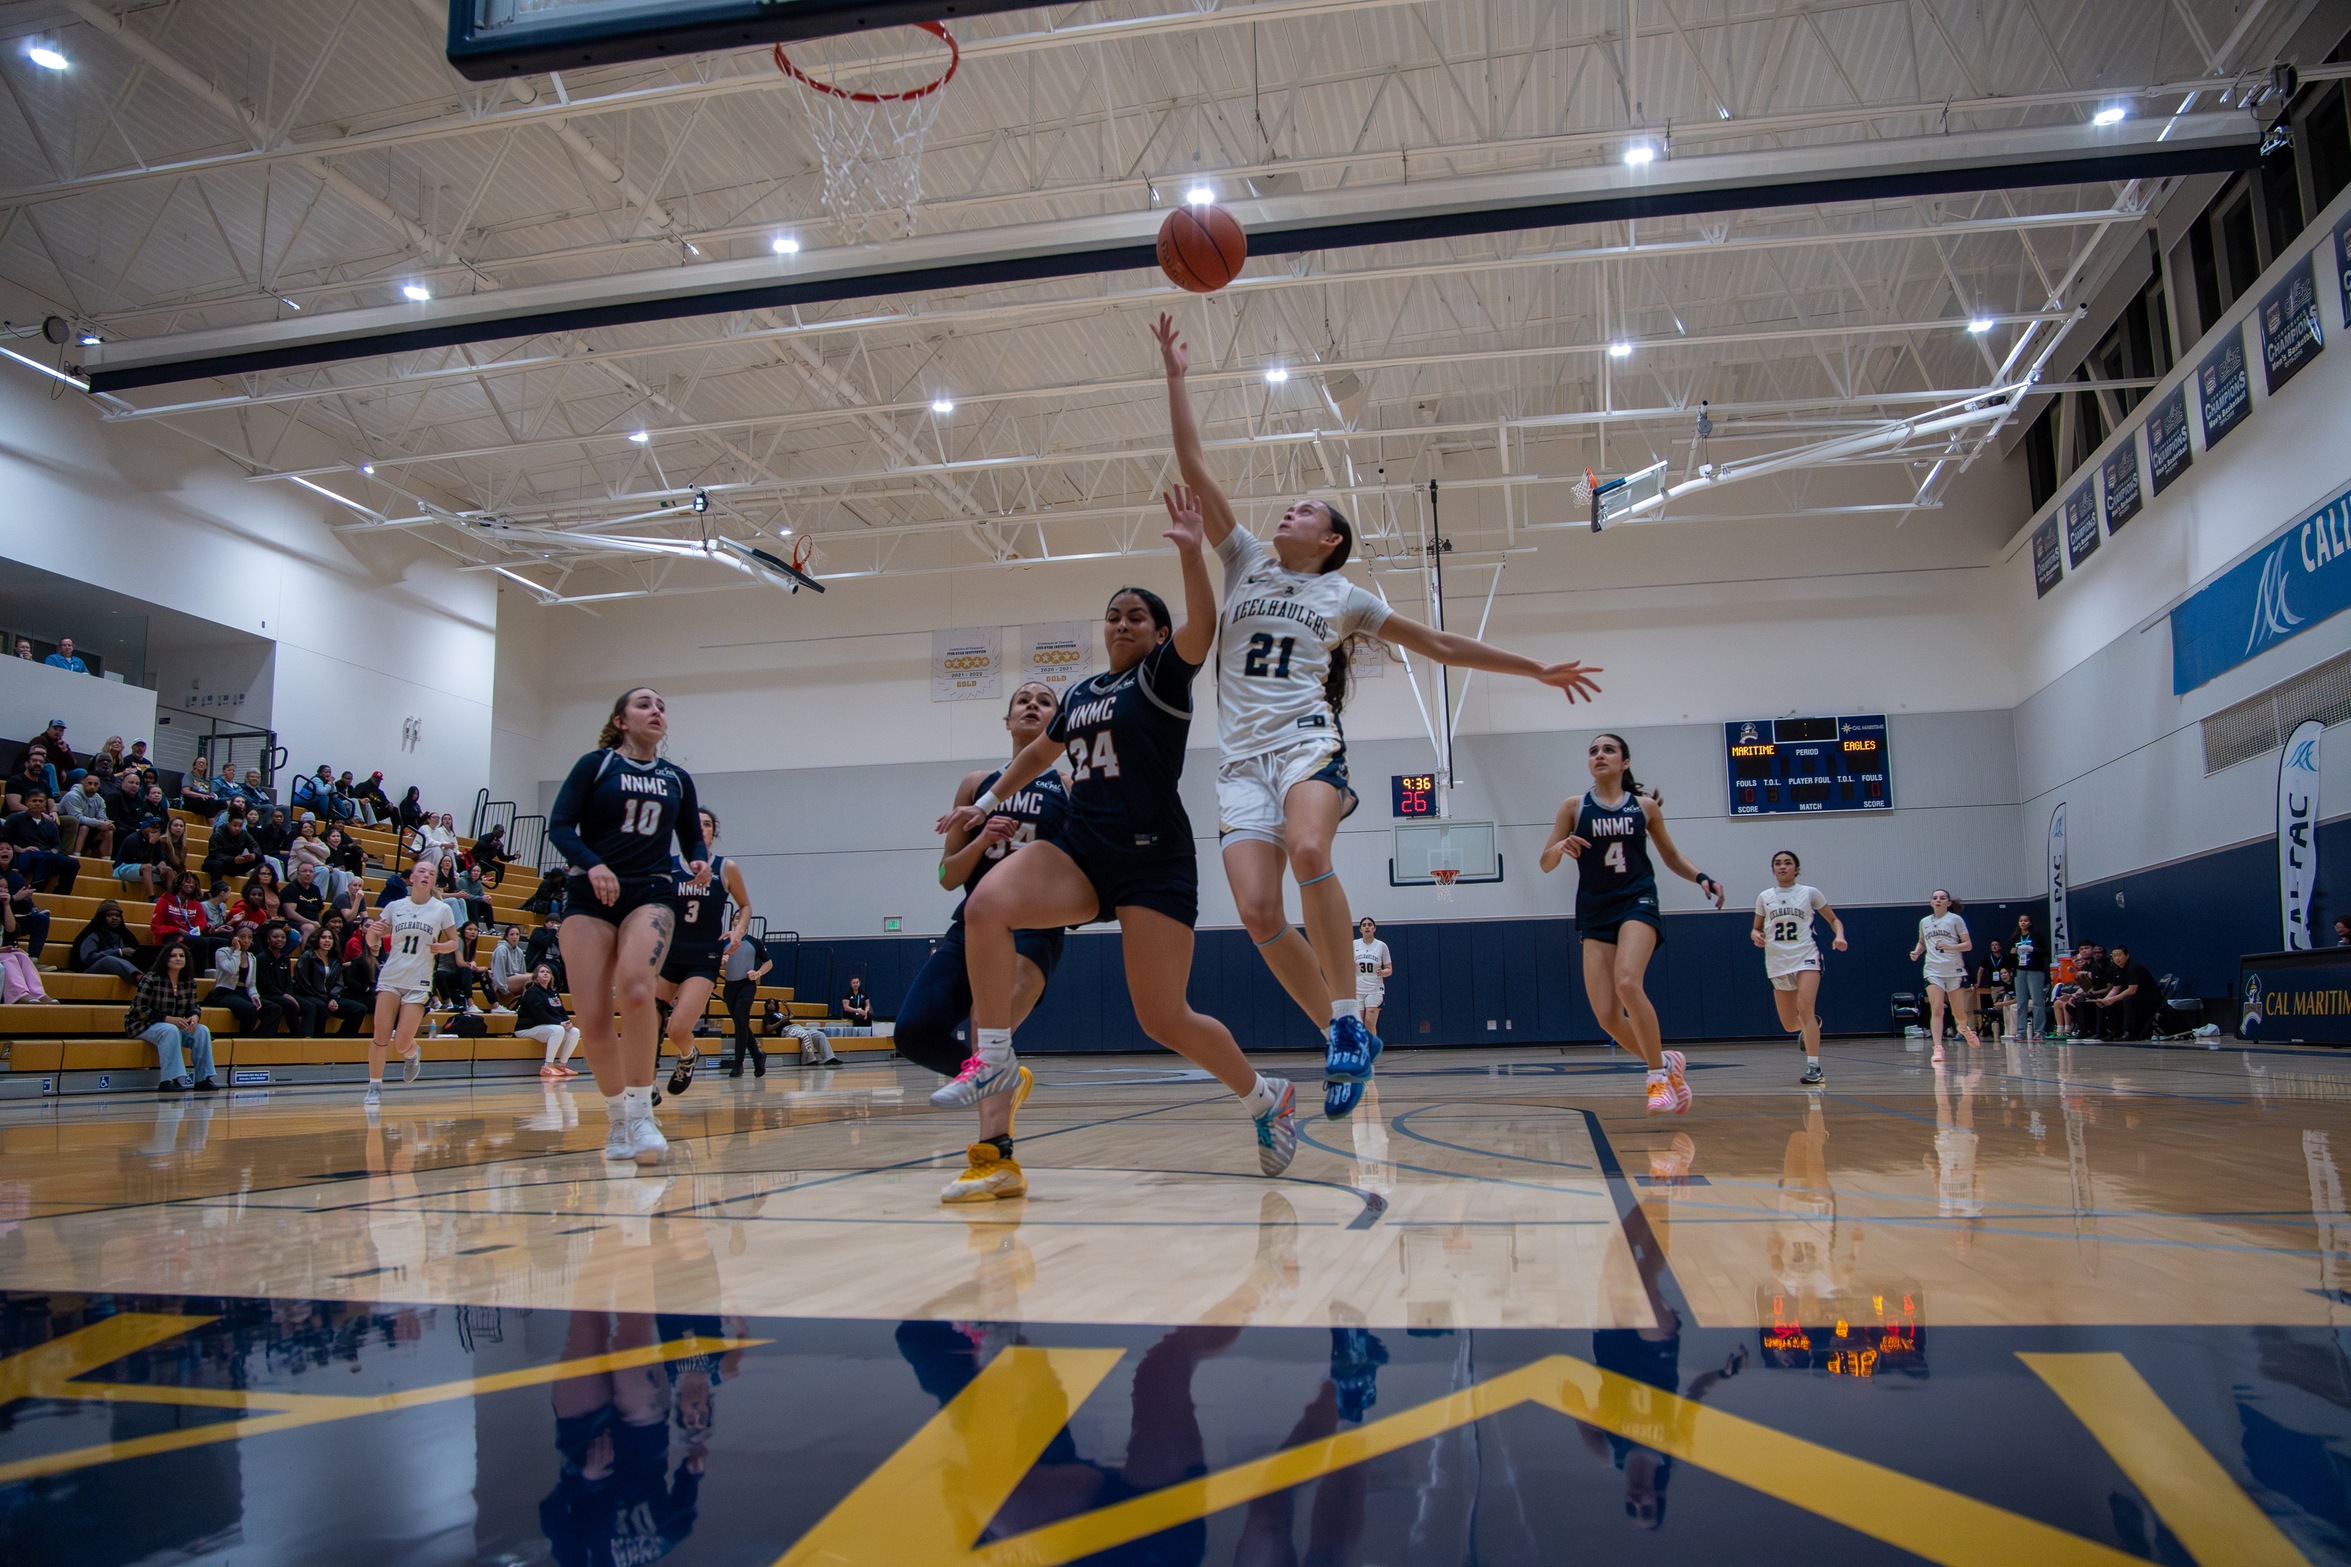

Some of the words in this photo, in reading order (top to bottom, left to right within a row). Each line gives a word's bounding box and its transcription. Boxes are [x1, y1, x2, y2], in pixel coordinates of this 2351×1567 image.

[2204, 370, 2246, 420] CHAMPIONS
[1232, 598, 1328, 642] KEELHAULERS
[1244, 632, 1296, 678] 21
[1066, 696, 1117, 732] NNMC
[1069, 730, 1120, 781] 24
[1732, 745, 1774, 756] MARITIME
[1844, 741, 1875, 751] EAGLES
[621, 774, 668, 796] NNMC
[1403, 778, 1430, 790] 9:36
[994, 791, 1043, 815] NMC
[1402, 791, 1427, 812] 26
[621, 799, 662, 836] 10
[1592, 817, 1634, 837] NNMC
[1604, 842, 1627, 873] 4
[684, 900, 700, 923] 3
[1775, 922, 1798, 941] 22
[402, 936, 419, 954] 11
[1359, 962, 1373, 973] 30
[2266, 992, 2289, 1016] CAL
